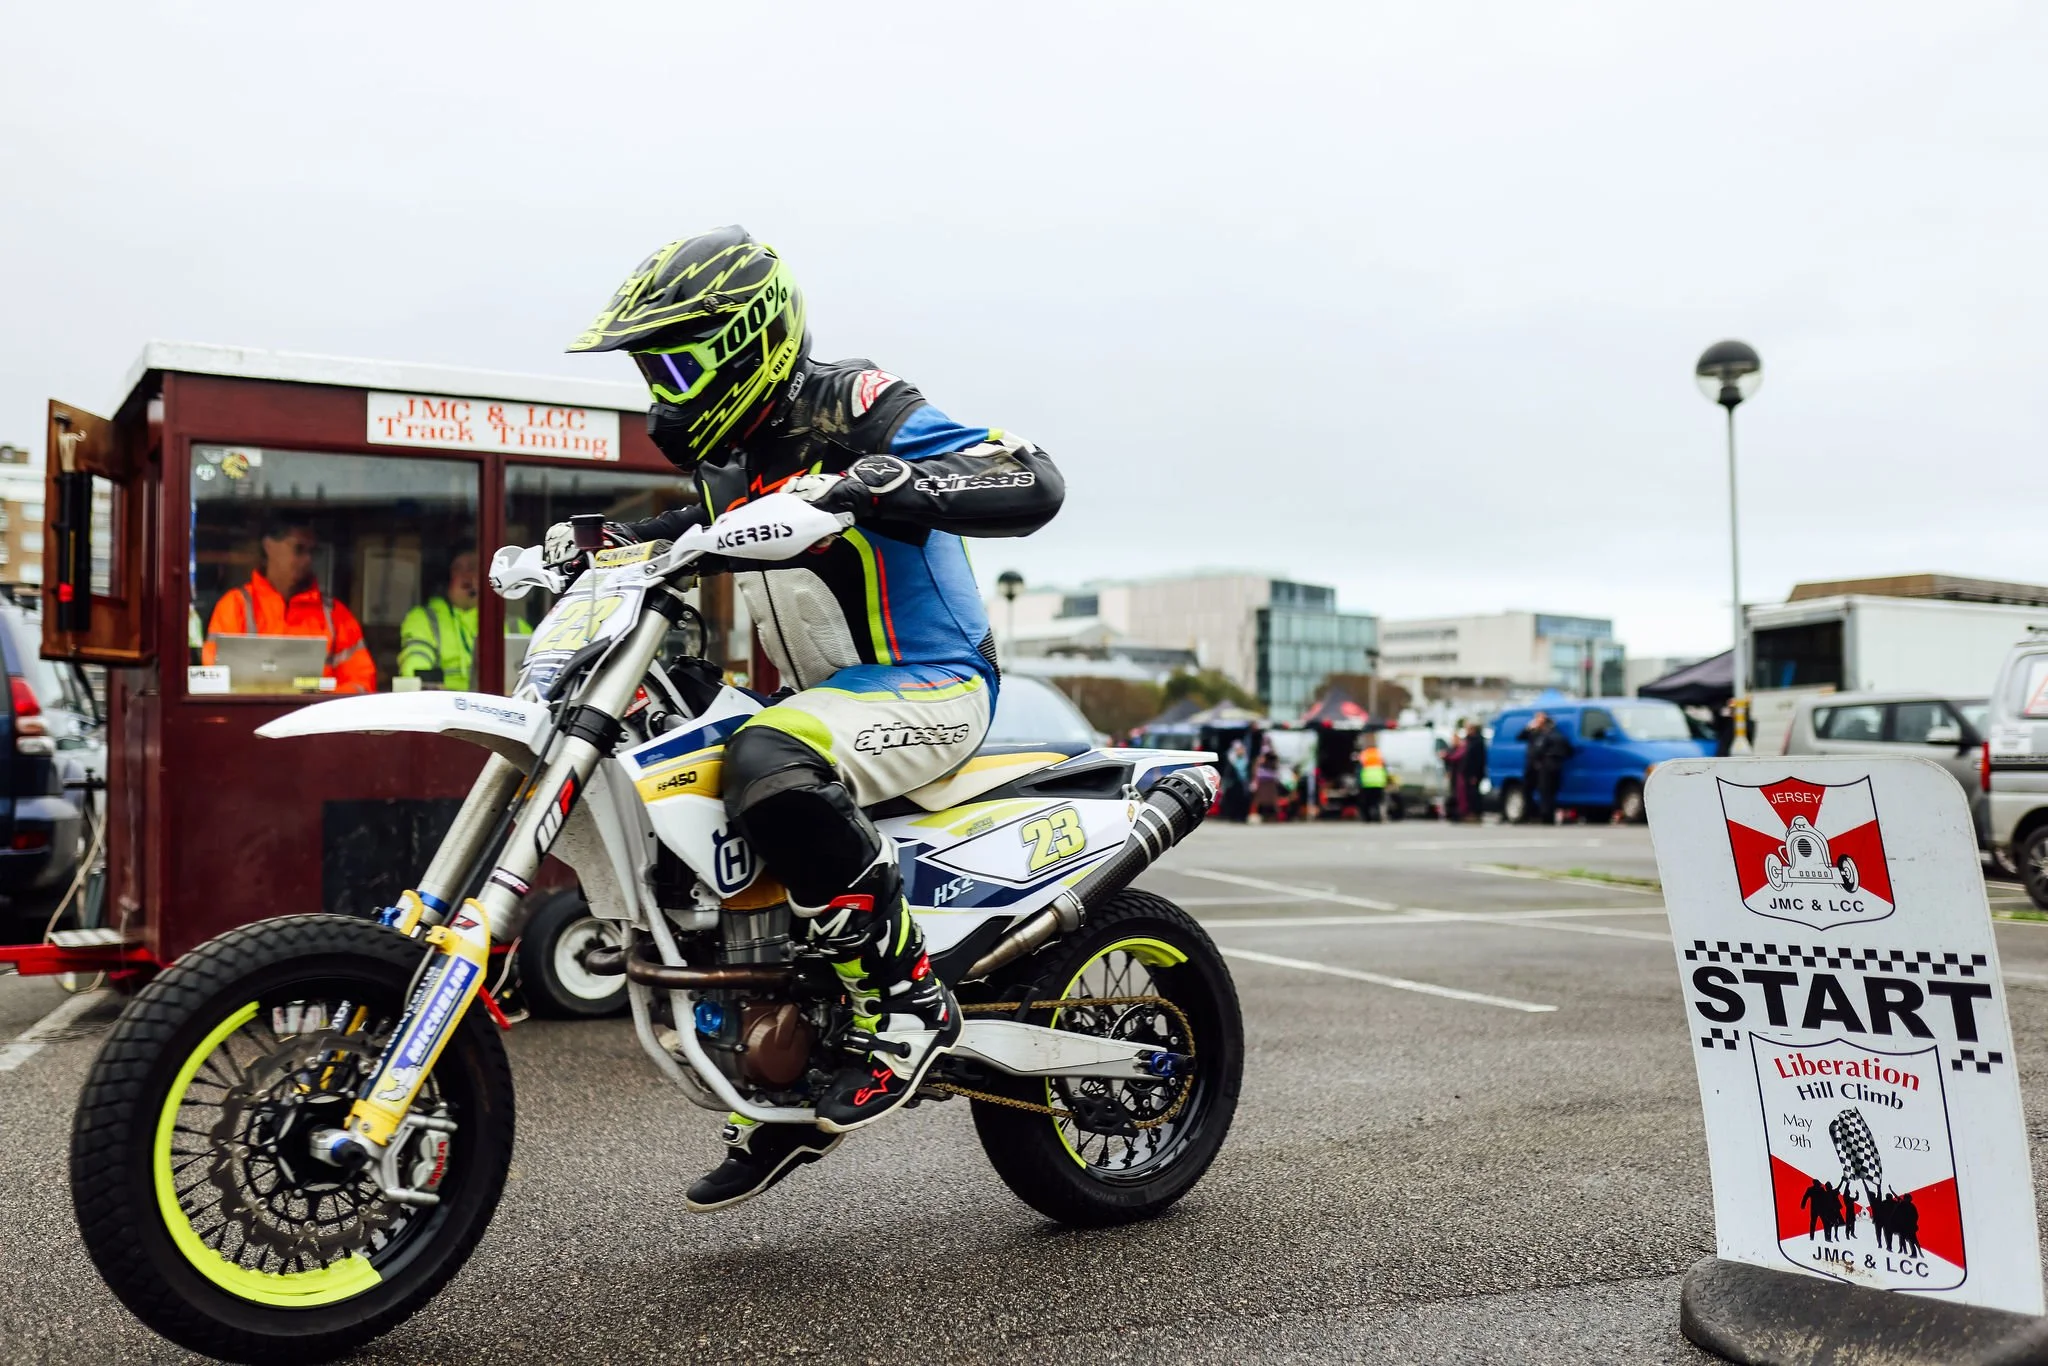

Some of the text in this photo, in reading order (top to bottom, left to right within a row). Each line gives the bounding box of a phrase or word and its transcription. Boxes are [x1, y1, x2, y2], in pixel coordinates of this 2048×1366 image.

[708, 276, 788, 363] 100%
[773, 347, 793, 376] BELL
[398, 398, 586, 431] JMC & LCC
[377, 416, 609, 460] Track Timing
[855, 722, 970, 755] alpinestars
[668, 770, 698, 787] 450
[1770, 791, 1821, 805] JERSEY
[1018, 806, 1086, 876] 23
[933, 873, 975, 908] HS2
[1769, 897, 1865, 913] JMC & LCC
[405, 959, 472, 1064] MICHELIN
[1692, 966, 1993, 1043] START
[1774, 1053, 1920, 1091] Liberation
[1796, 1081, 1904, 1110] Hill Climb
[1783, 1113, 1813, 1132] May
[1789, 1134, 1931, 1152] 9th 2023
[426, 1140, 449, 1187] brembo
[1812, 1246, 1930, 1278] JMC & LCC
